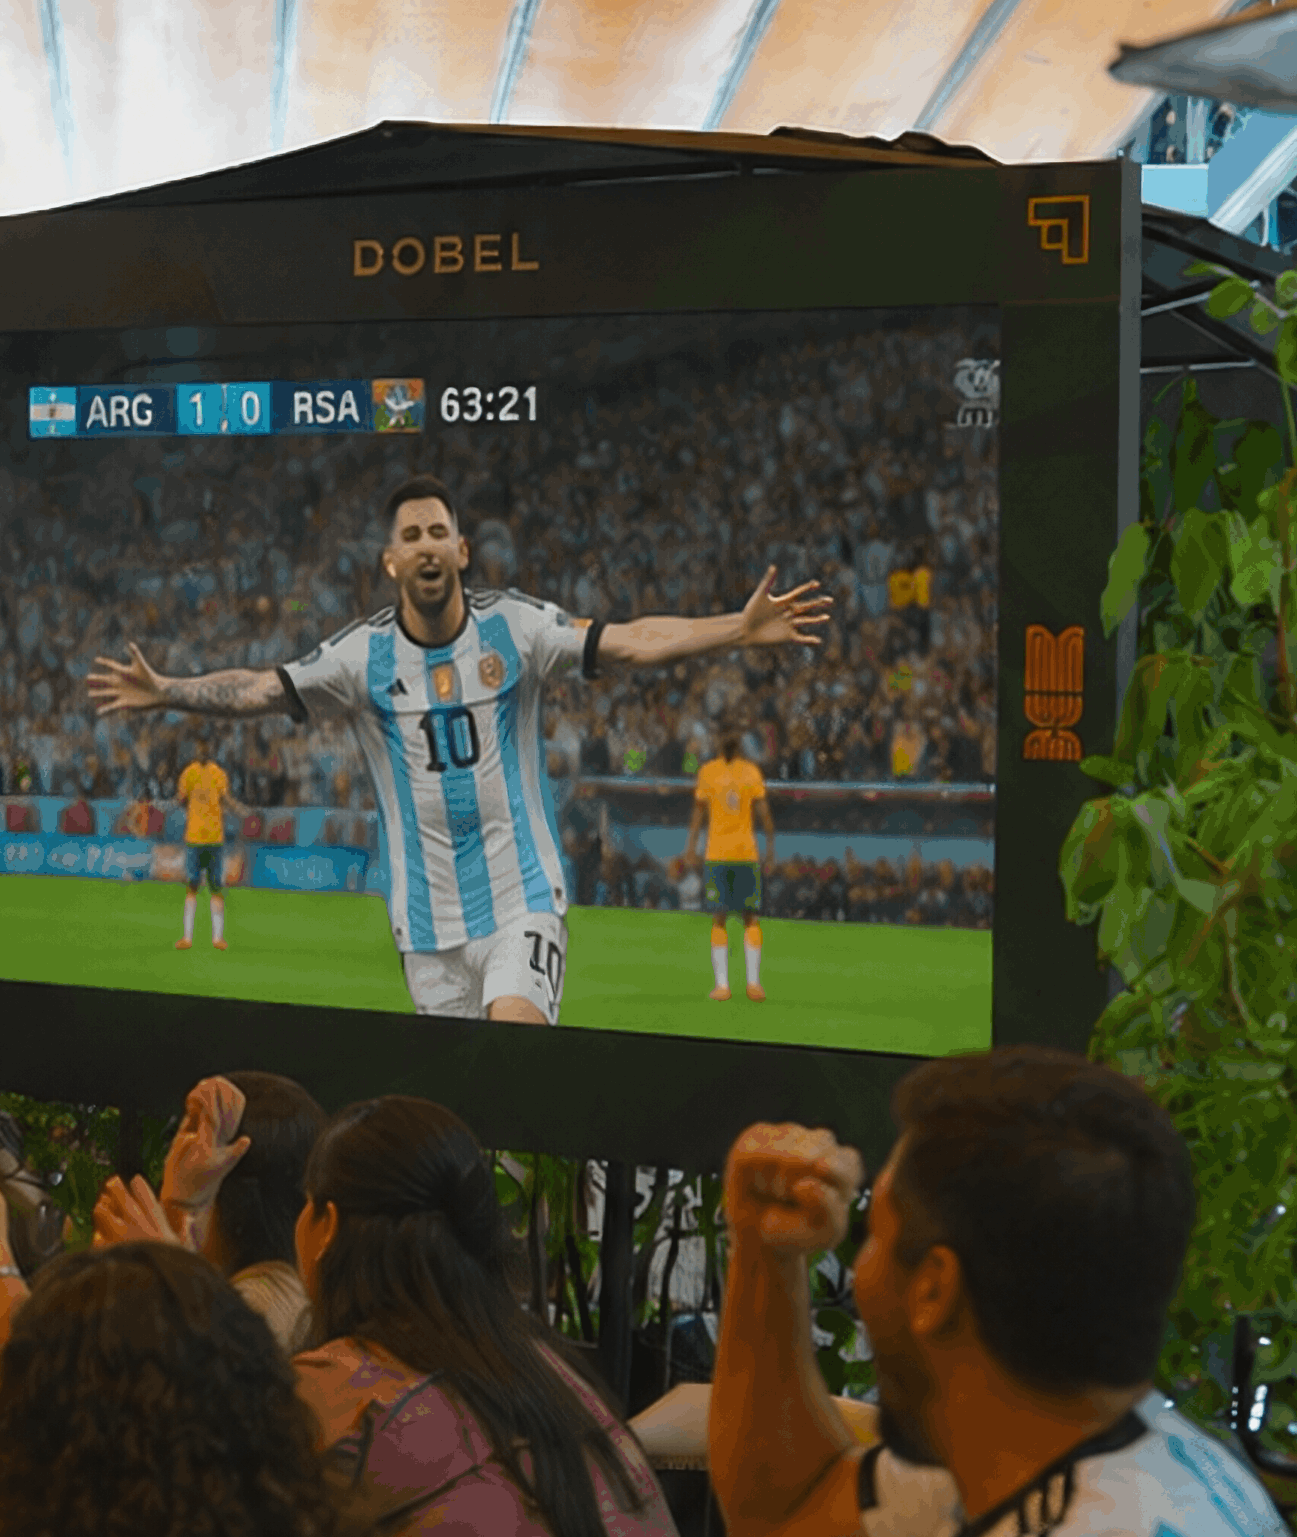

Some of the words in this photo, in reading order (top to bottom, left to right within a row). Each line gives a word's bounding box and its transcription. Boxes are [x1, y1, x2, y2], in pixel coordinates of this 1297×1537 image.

[353, 233, 539, 276] DOBEL
[86, 394, 153, 429] ARG
[293, 390, 360, 425] RSA
[440, 386, 538, 423] 63:21
[419, 706, 480, 772] 10
